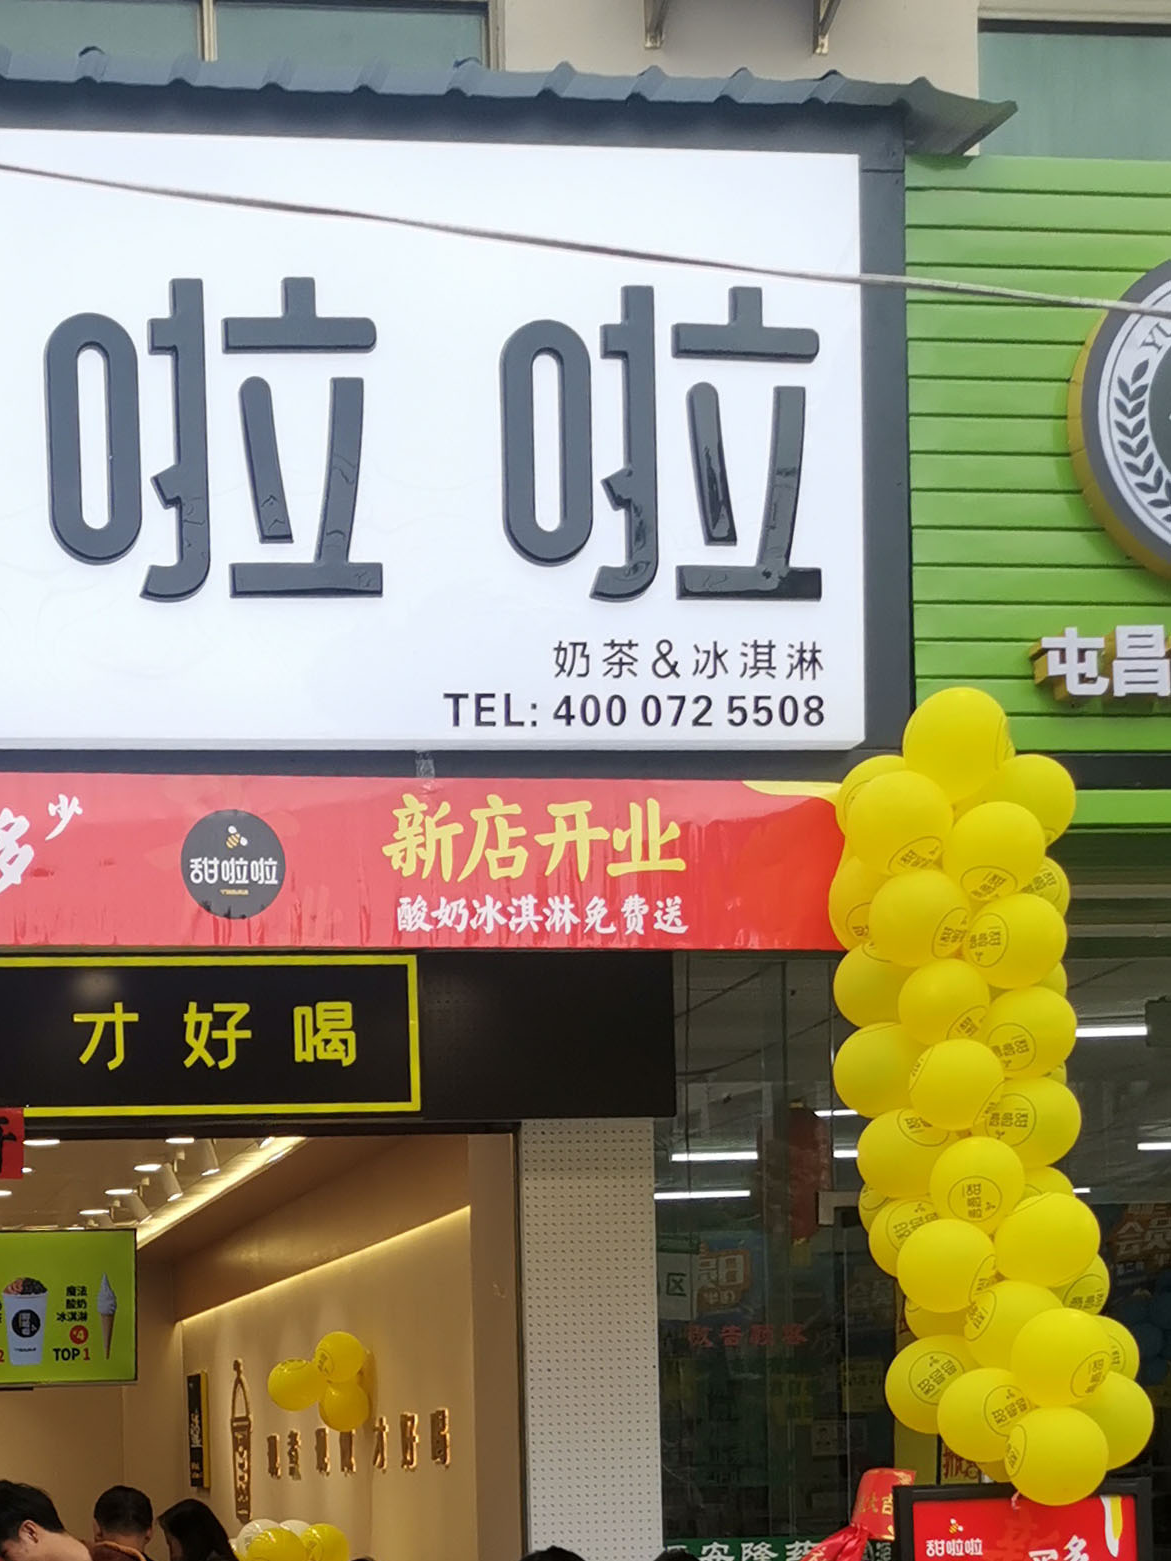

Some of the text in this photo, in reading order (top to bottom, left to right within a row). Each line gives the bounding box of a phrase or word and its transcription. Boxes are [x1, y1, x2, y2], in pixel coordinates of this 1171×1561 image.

[552, 638, 824, 682] 奶茶&冰淇淋
[1040, 624, 1171, 697] 屯昌
[443, 693, 825, 730] TEL: 400 072 5508
[381, 793, 688, 885] 新店开业
[189, 857, 279, 885] 甜啦啦
[76, 1002, 358, 1070] 才好喝
[53, 1348, 80, 1361] TOP
[926, 1538, 983, 1557] 甜啦啦
